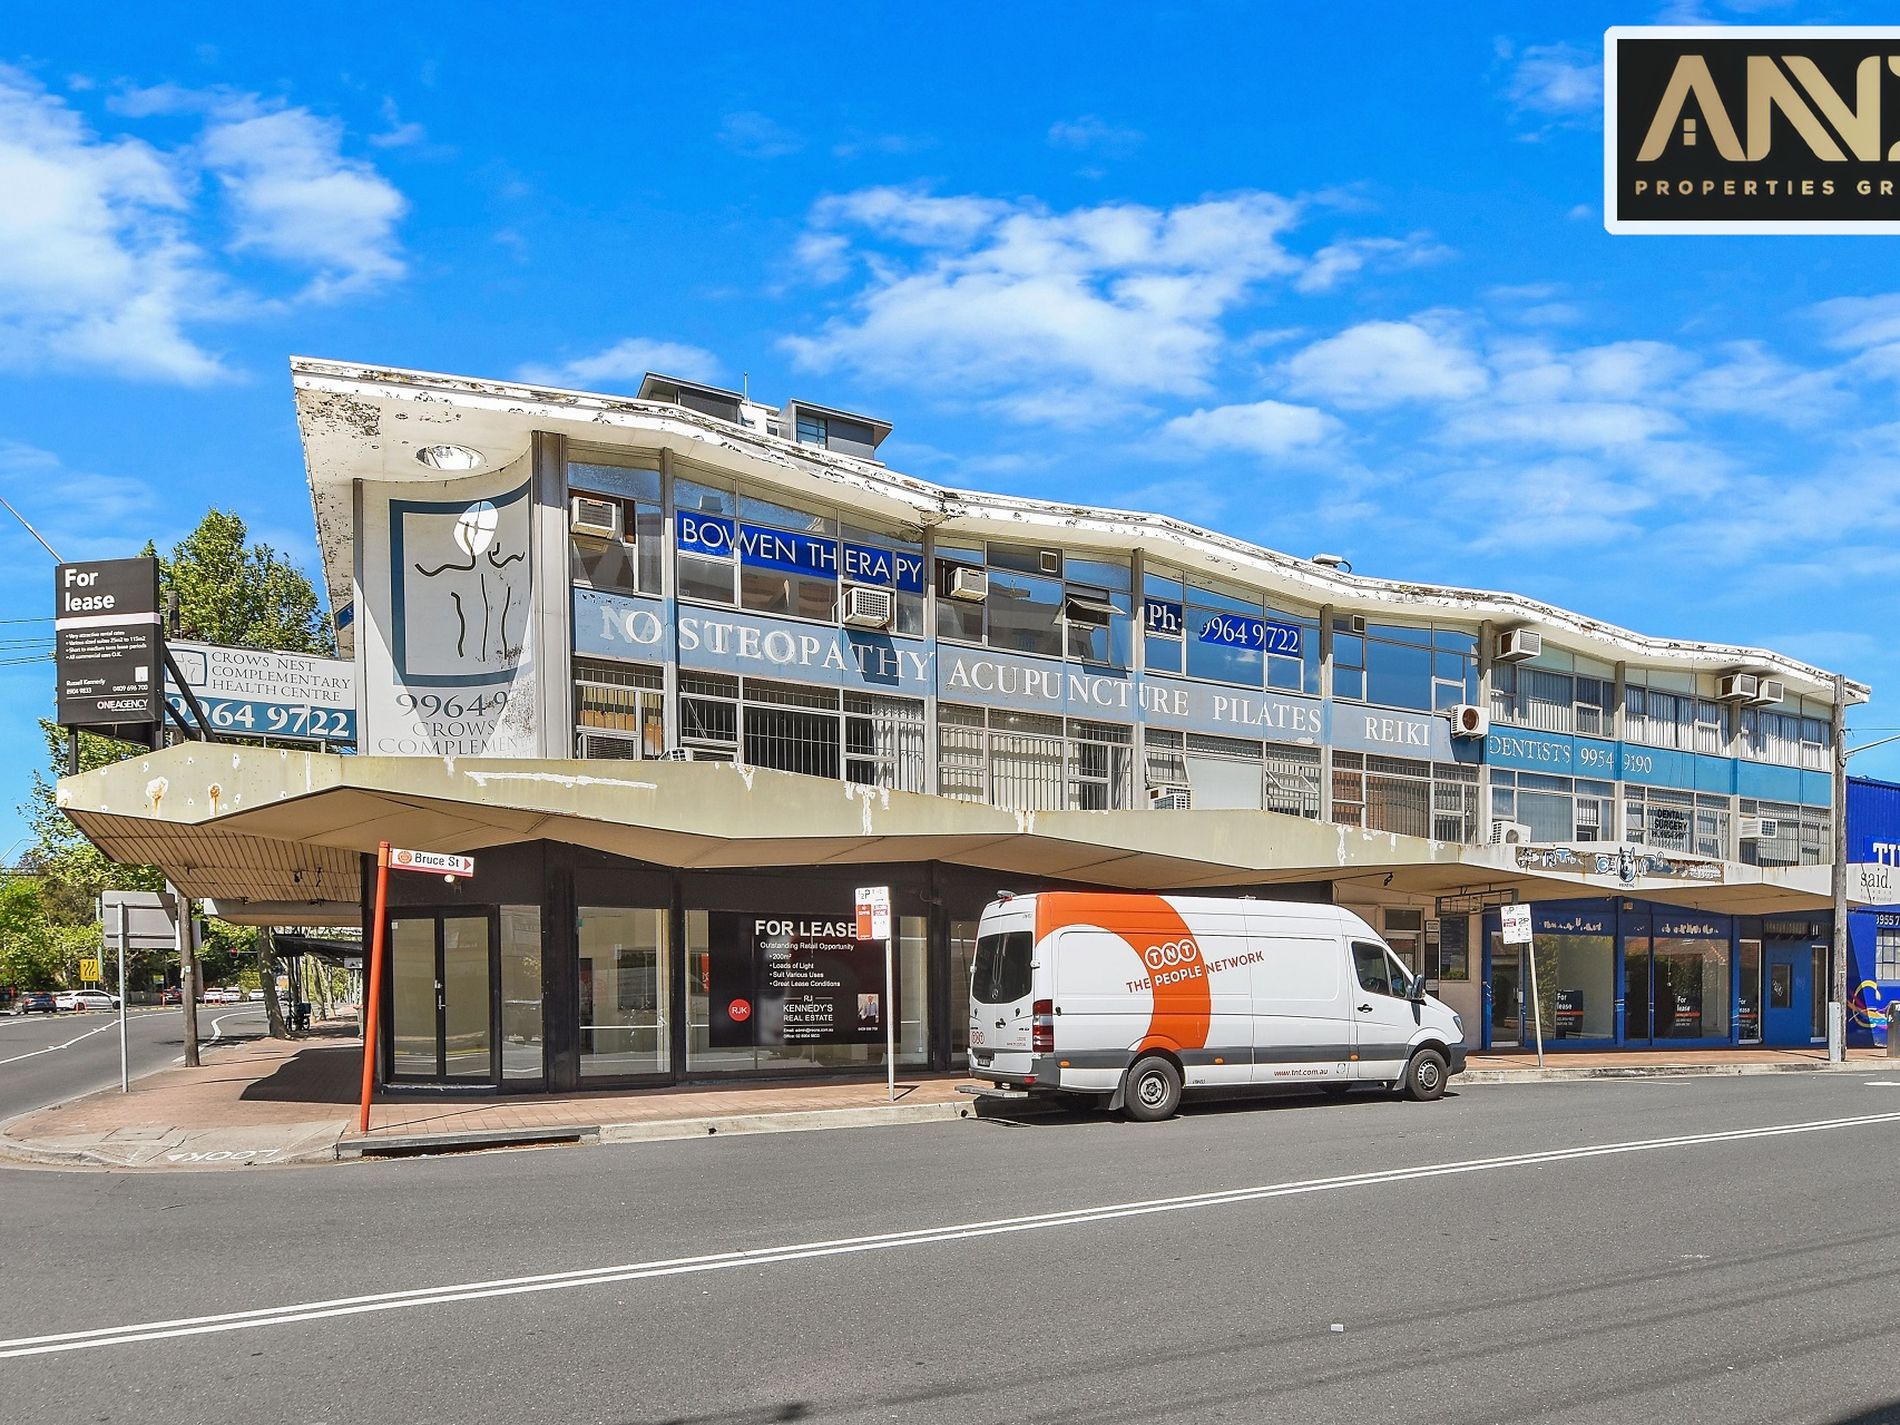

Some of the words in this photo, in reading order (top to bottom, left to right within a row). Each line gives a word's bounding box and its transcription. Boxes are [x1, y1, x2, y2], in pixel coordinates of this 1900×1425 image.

[683, 517, 796, 564] BOWEN
[806, 542, 922, 583] THERAPY
[64, 568, 99, 588] For
[65, 591, 115, 612] lease
[1253, 624, 1299, 652] 9722
[211, 651, 270, 667] CROWS
[277, 658, 315, 673] NEST
[212, 666, 351, 690] COMPLEMENTARY
[213, 680, 277, 696] HEALTH
[281, 686, 341, 702] CENTRE
[947, 657, 1189, 716] ACUPUNCTURE
[1212, 695, 1322, 733] PILATES
[1364, 716, 1430, 746] REIKI
[267, 707, 350, 737] 9722
[412, 720, 496, 737] CROWS
[1489, 736, 1571, 764] DENTISTS
[1580, 748, 1614, 770] 9954
[1657, 809, 1684, 820] DENTAL
[1654, 819, 1687, 831] SURGERY
[415, 853, 444, 866] Bruce
[448, 856, 459, 867] St
[1873, 842, 1900, 867] TI
[1860, 867, 1892, 889] said.
[755, 920, 795, 936] FOR
[800, 921, 857, 938] LEASE
[760, 941, 798, 950] Outstanding
[819, 943, 854, 951] Opportunity
[1147, 941, 1194, 967] TNT
[799, 962, 814, 970] Light
[1126, 977, 1151, 993] THE
[1154, 965, 1203, 987] PEOPLE
[1206, 950, 1265, 974] NETWORK
[1556, 992, 1567, 1000] For
[1556, 1001, 1572, 1010] lease
[1677, 995, 1686, 1003] For
[731, 1006, 748, 1014] RJK
[783, 1004, 833, 1012] KENNEDY'S
[783, 1014, 803, 1022] REAL
[805, 1014, 833, 1022] ESTATE
[1274, 1068, 1329, 1077] www.tnt.com.au
